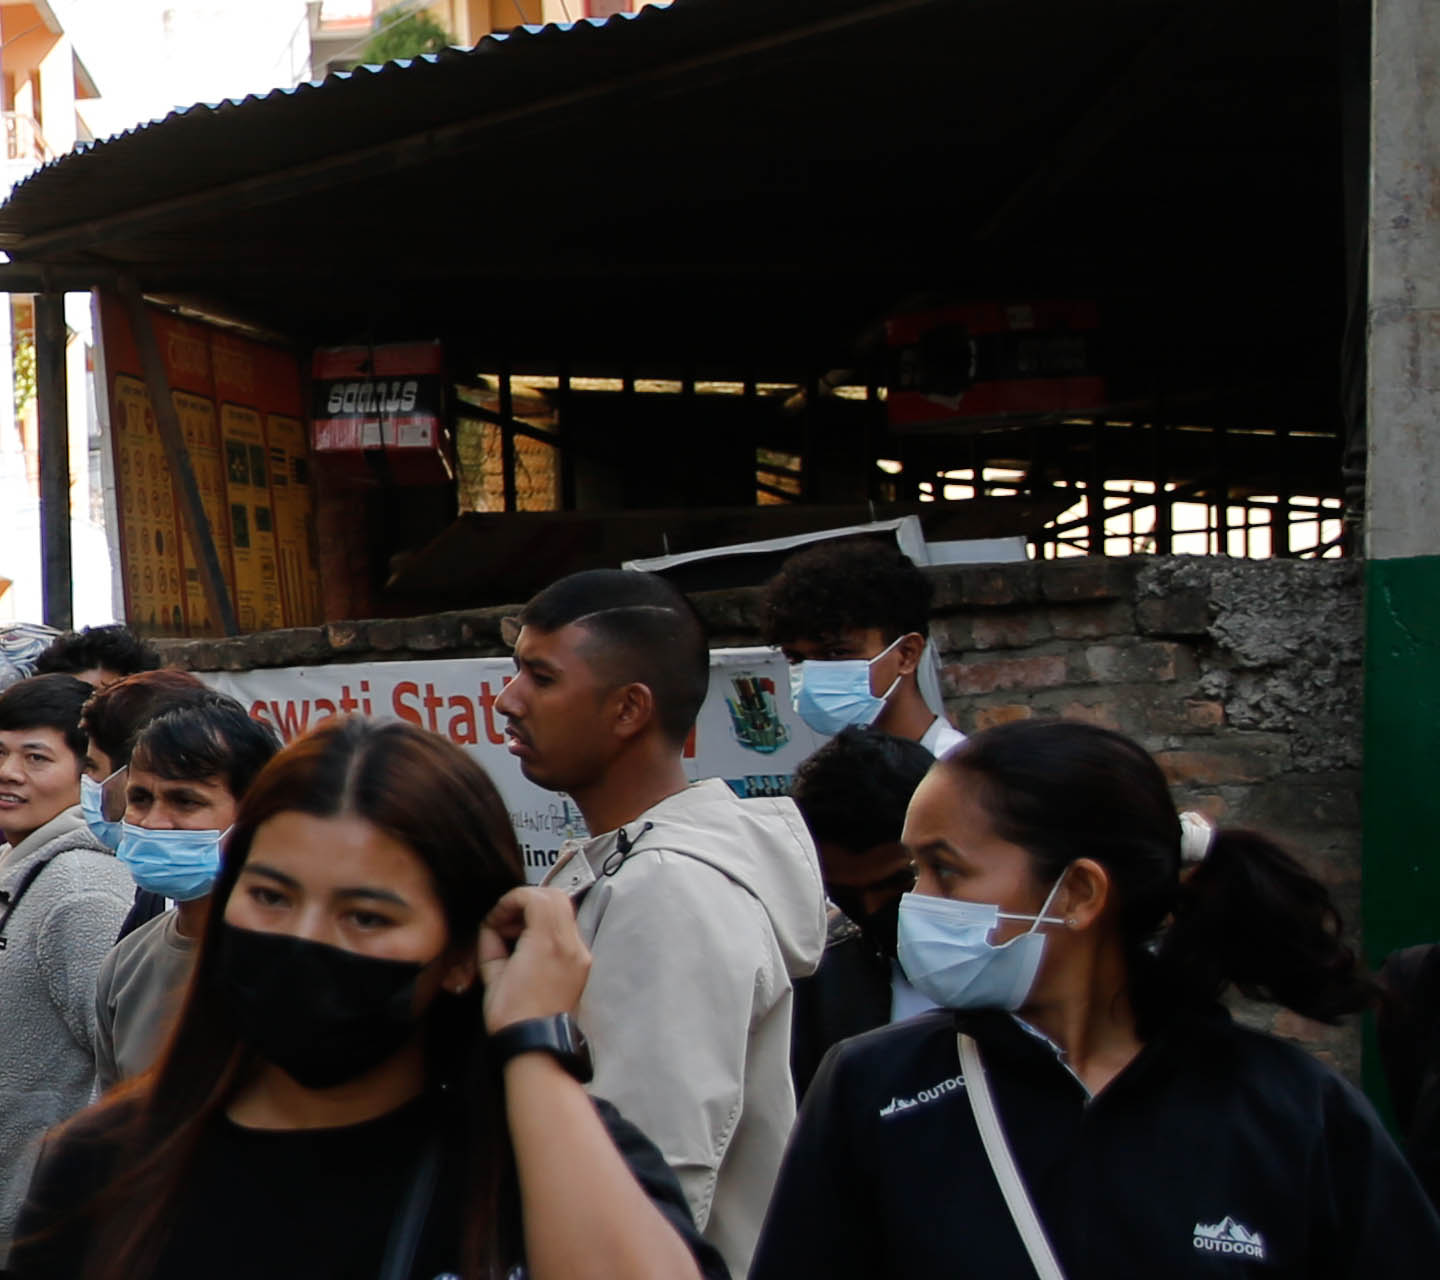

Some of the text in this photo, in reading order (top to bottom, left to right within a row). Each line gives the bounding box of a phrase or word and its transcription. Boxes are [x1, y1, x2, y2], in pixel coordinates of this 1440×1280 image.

[327, 380, 418, 414] STUDDS
[392, 675, 508, 746] Stat
[1193, 1236, 1265, 1259] OUTDOOR
